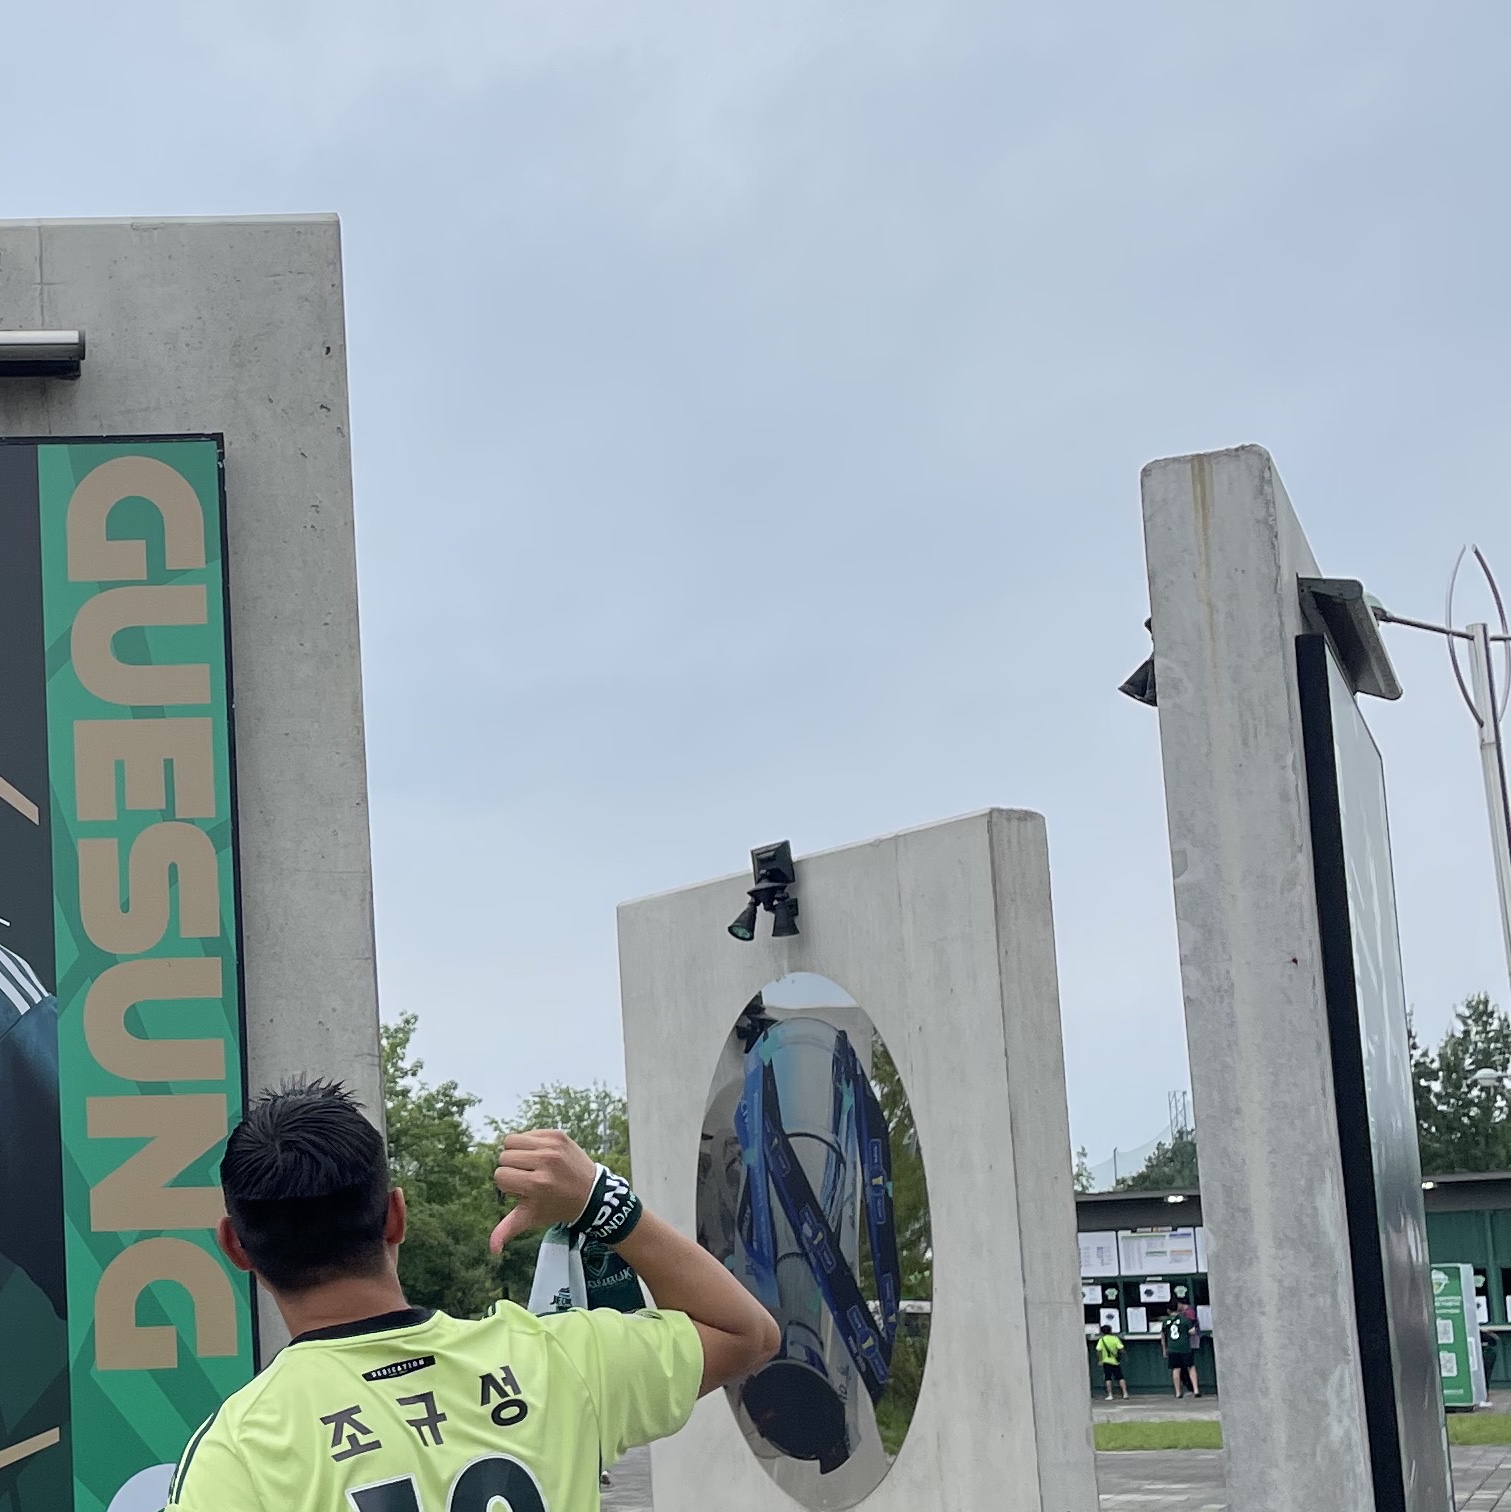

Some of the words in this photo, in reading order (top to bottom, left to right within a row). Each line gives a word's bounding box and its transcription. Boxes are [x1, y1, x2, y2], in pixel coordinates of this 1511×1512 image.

[66, 455, 239, 1370] GUESUNG
[1169, 1324, 1180, 1340] 8
[319, 1365, 529, 1463] 조규성
